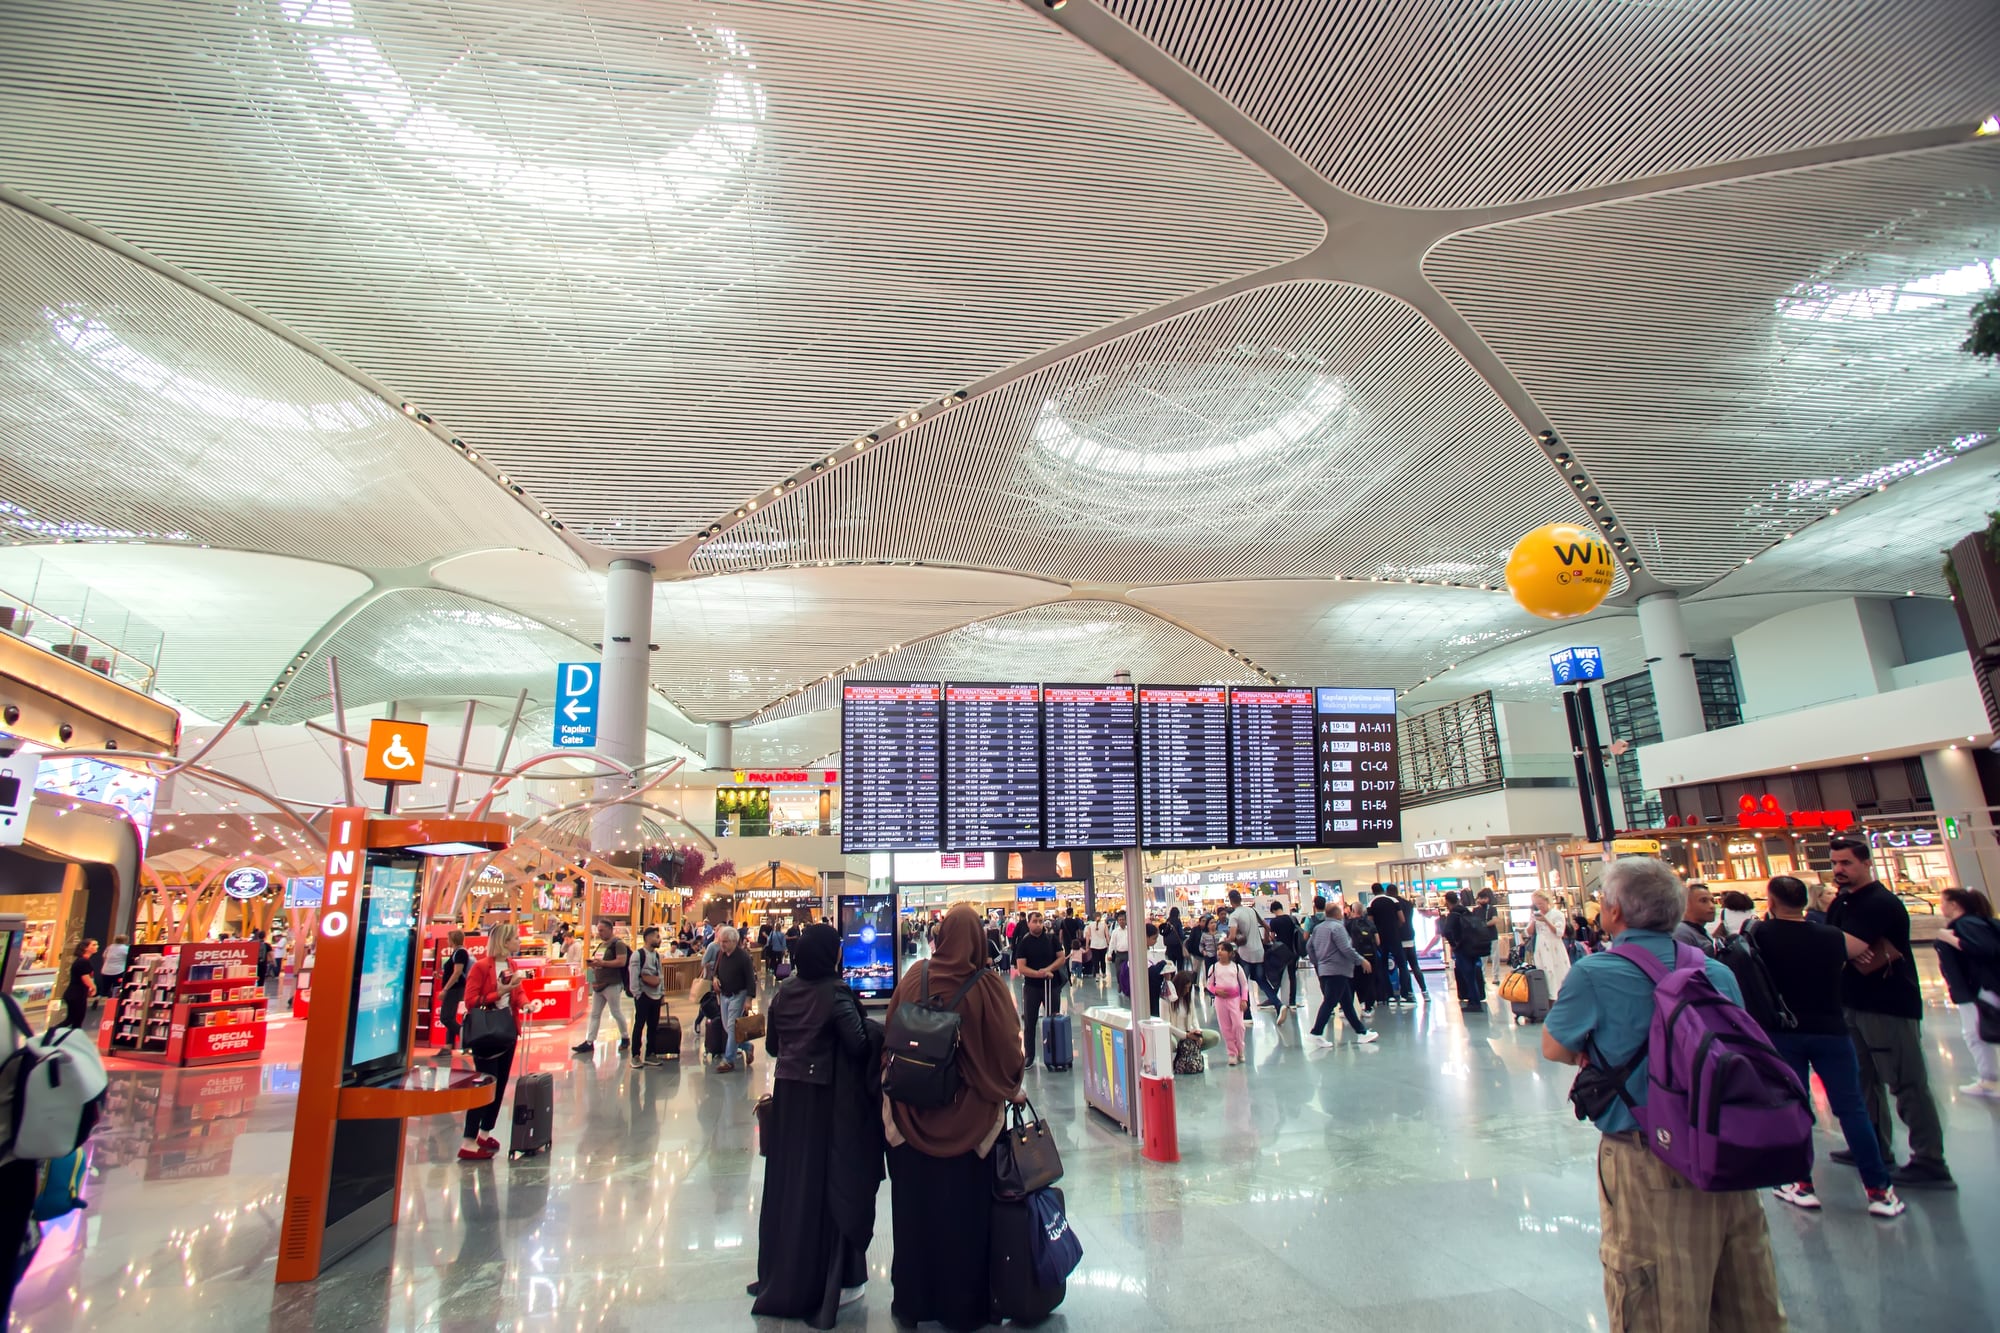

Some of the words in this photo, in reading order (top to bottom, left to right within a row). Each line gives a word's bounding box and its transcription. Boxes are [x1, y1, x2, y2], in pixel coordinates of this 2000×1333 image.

[1551, 650, 1572, 665] WiFi
[1575, 648, 1598, 660] WiFi
[566, 664, 593, 696] D
[1360, 722, 1391, 732] A1-A11
[561, 736, 584, 744] Gates
[1360, 742, 1391, 752] B1-B18
[1360, 761, 1388, 771] C1-C4
[748, 772, 774, 784] PAŞA
[775, 771, 808, 782] DÖNER
[1362, 780, 1395, 790] D1-D17
[1362, 800, 1387, 810] E1-E4
[1362, 820, 1393, 830] F1-F19
[322, 820, 354, 937] INFO
[1160, 874, 1188, 885] MOOD
[1188, 873, 1200, 883] UP
[1208, 872, 1234, 882] COFFEE
[1237, 871, 1258, 880] JUICE
[1261, 869, 1289, 879] BAKERY
[194, 949, 248, 960] SPECIAL
[208, 1030, 254, 1043] SPECIAL
[212, 1040, 248, 1050] OFFER
